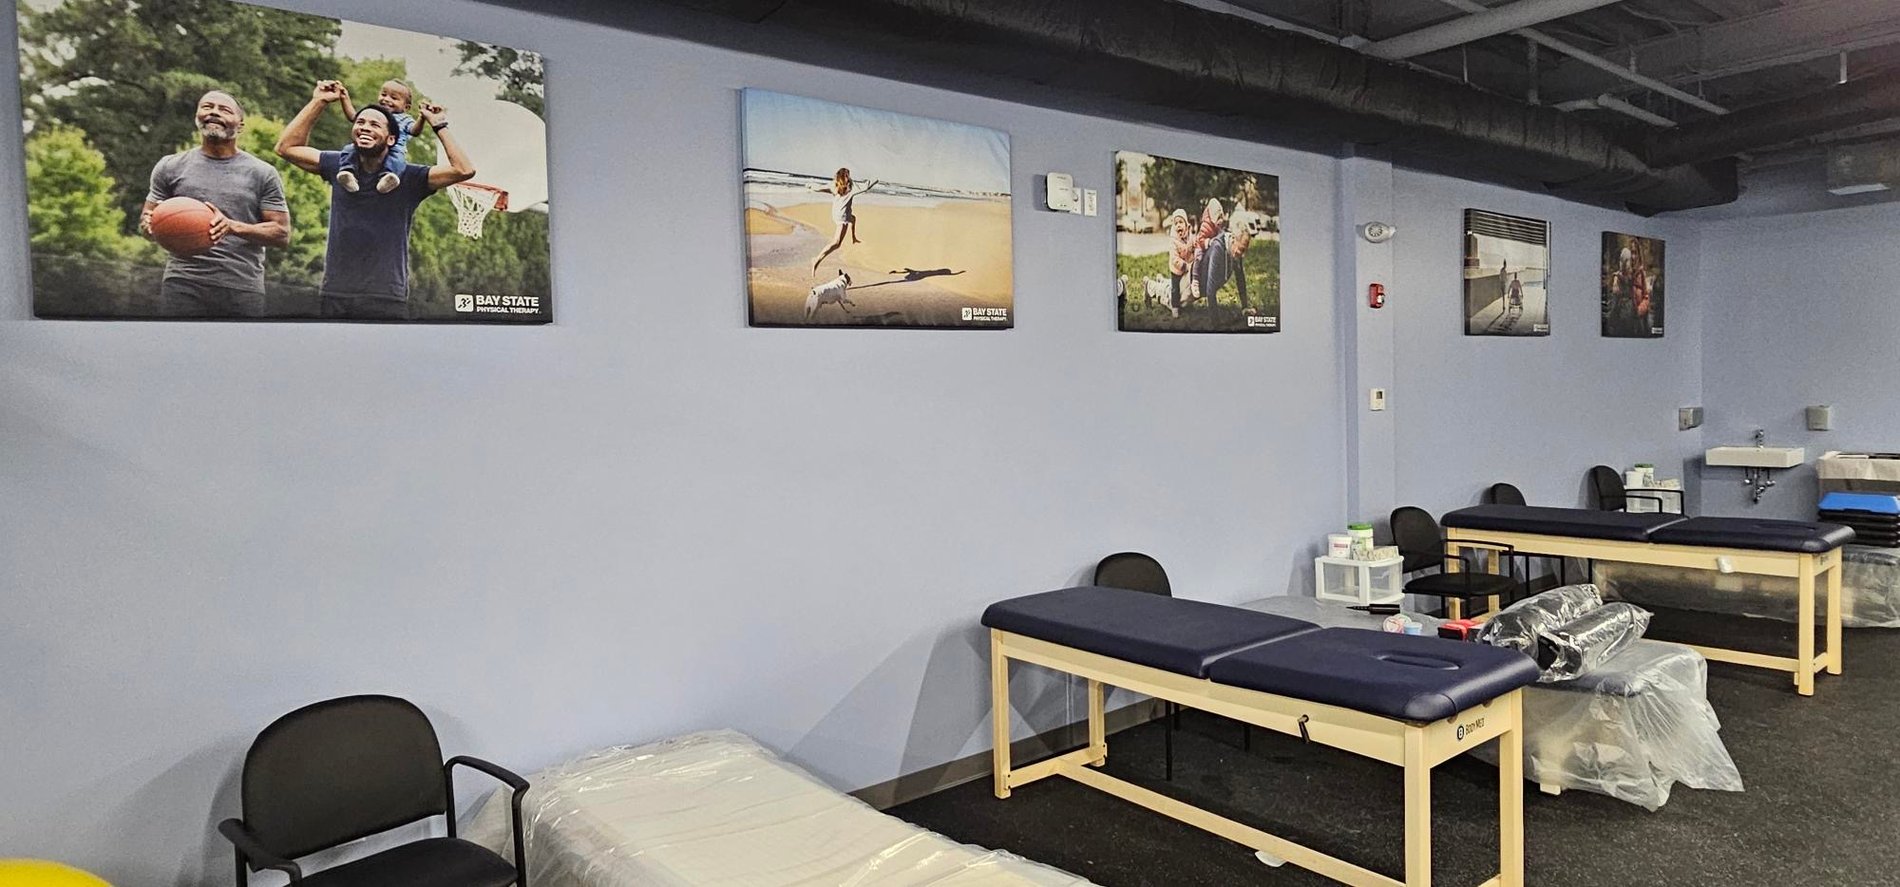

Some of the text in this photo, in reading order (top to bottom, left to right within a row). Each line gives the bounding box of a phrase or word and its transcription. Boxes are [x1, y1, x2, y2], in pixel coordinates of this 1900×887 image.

[476, 295, 539, 306] BAY STATE
[973, 308, 1007, 316] BAY STATE
